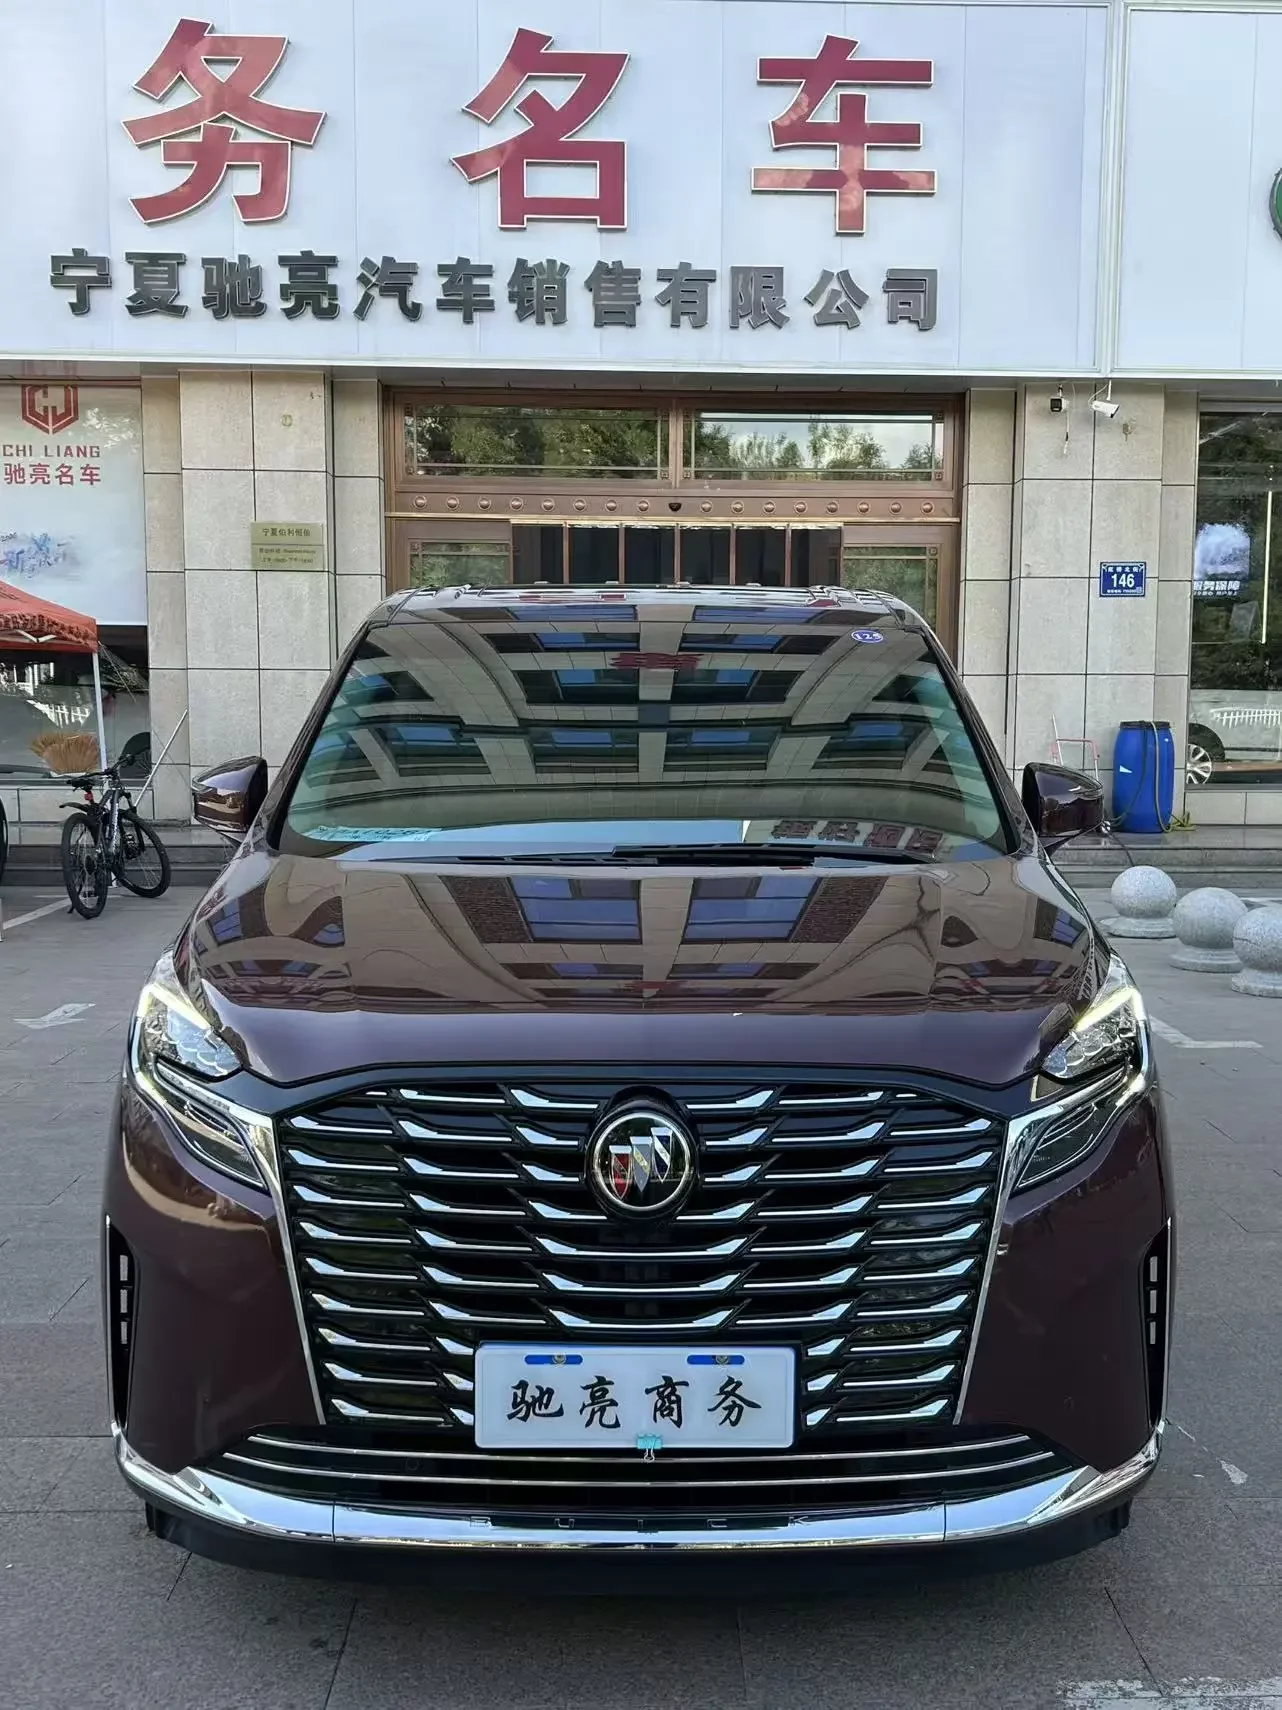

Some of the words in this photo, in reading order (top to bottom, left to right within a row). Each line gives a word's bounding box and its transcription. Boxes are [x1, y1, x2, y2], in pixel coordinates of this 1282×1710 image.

[121, 17, 937, 236] 务名车
[50, 248, 939, 330] 宁夏驰亮汽车销售有限公司
[2, 444, 33, 457] CHI
[44, 445, 101, 458] LIANG
[4, 463, 101, 486] 驰亮名车
[1111, 573, 1135, 588] 146
[507, 1374, 762, 1429] 驰亮商务
